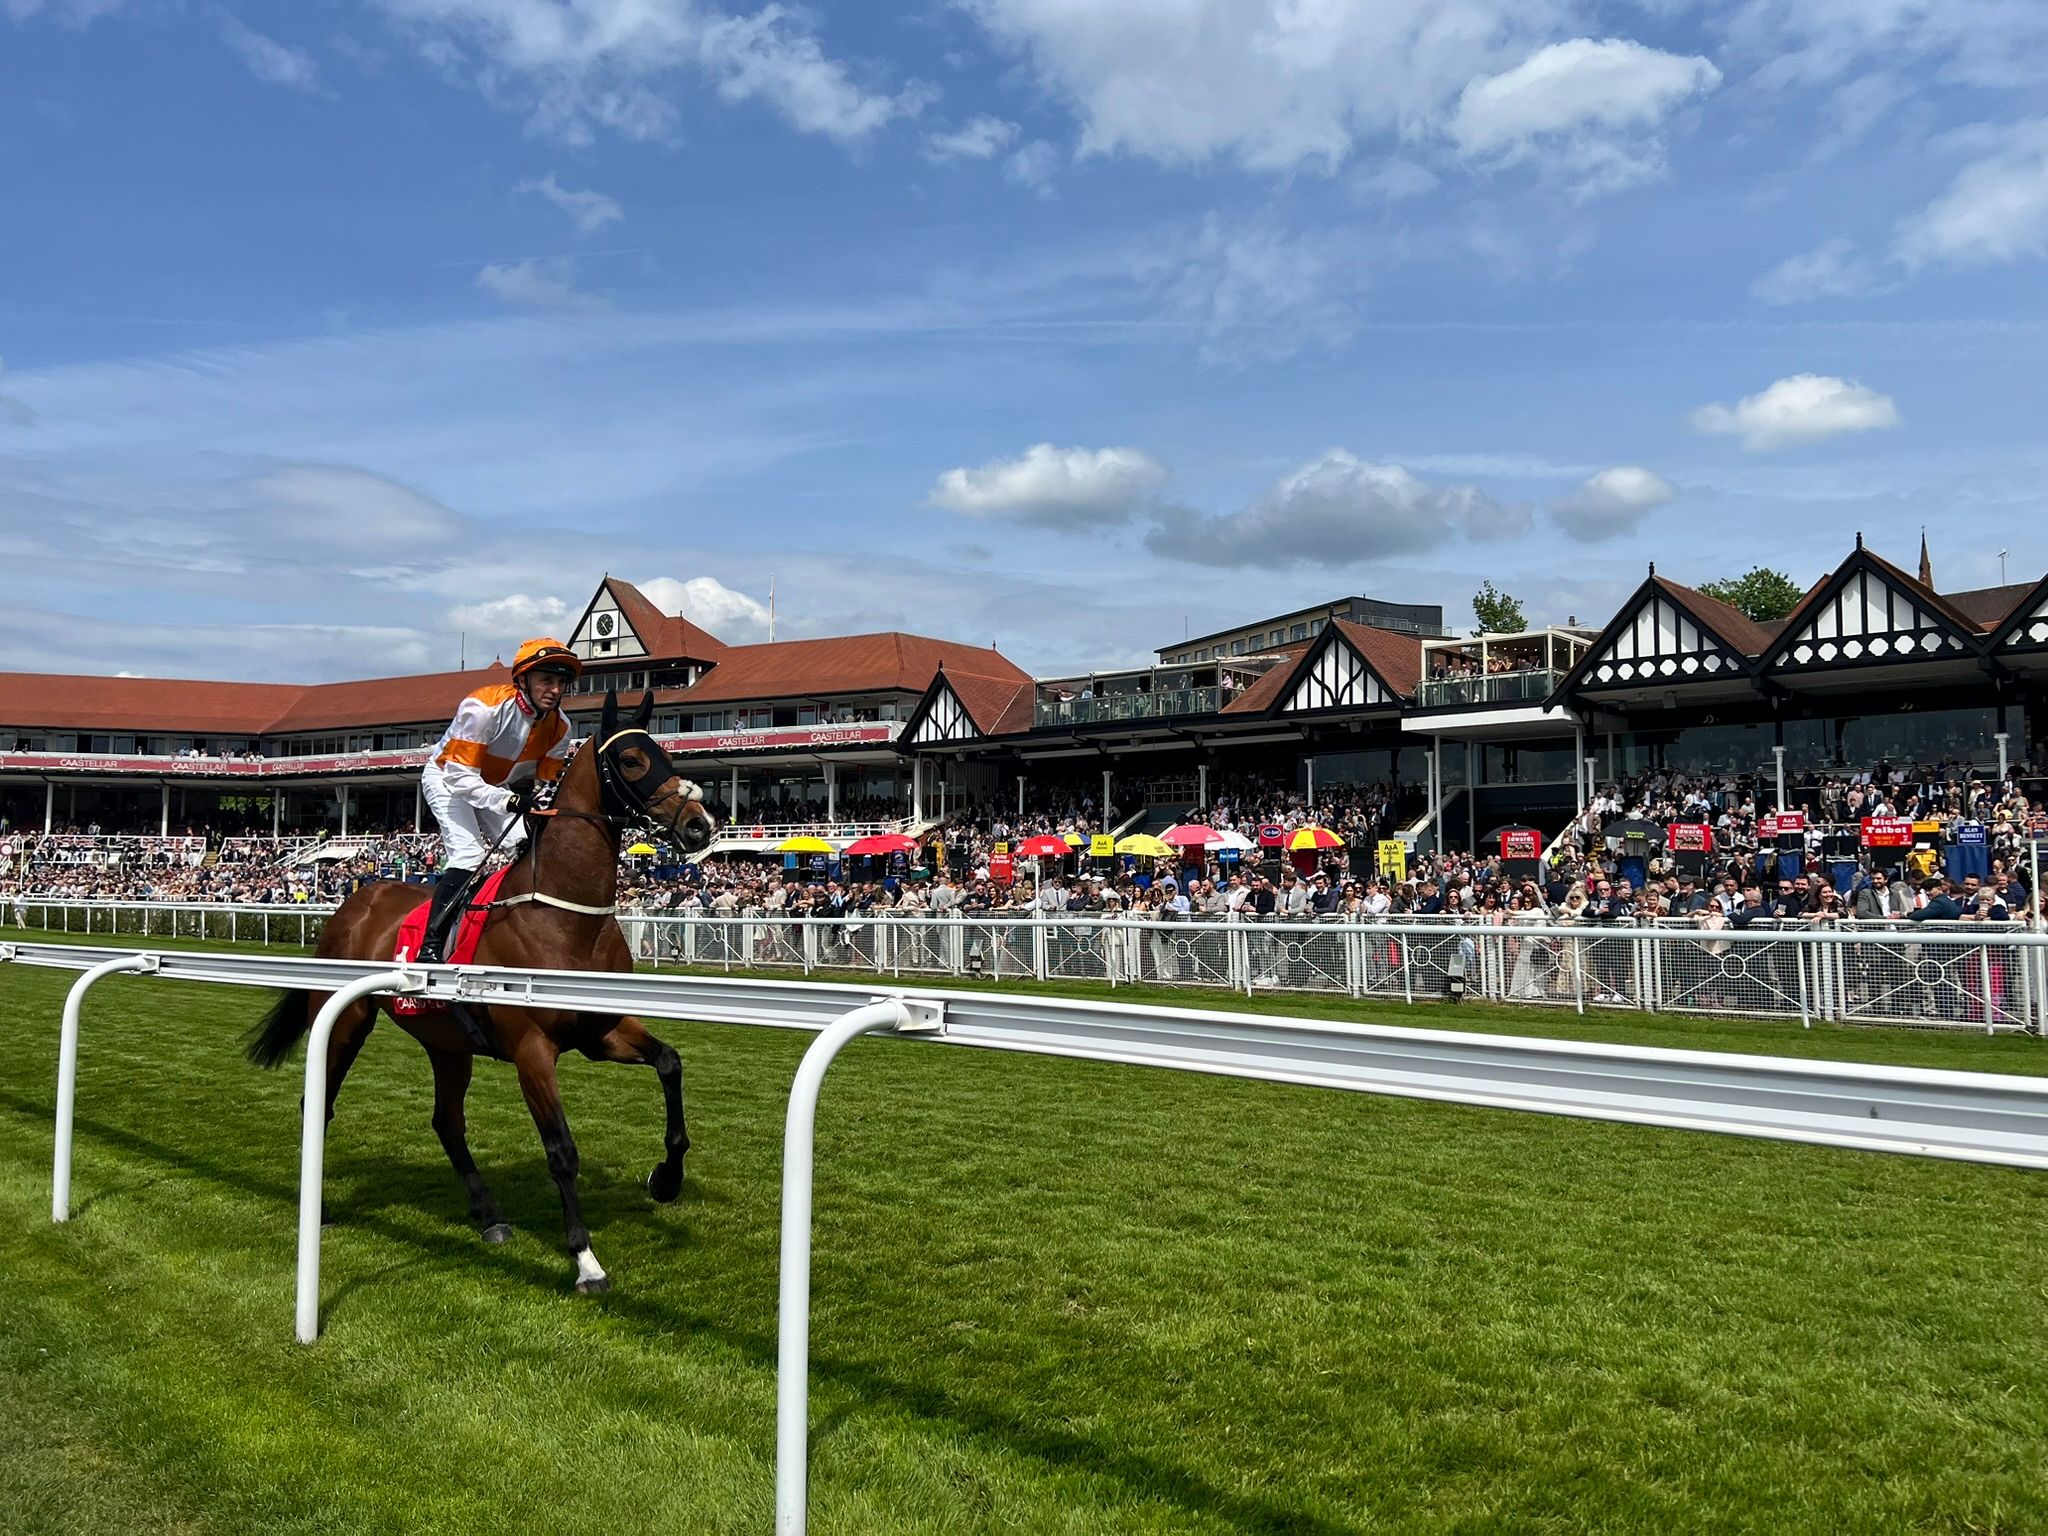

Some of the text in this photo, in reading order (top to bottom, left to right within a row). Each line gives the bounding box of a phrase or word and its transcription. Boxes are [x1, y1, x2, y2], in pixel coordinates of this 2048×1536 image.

[811, 731, 861, 741] CAASTELLAR
[717, 737, 765, 746] CAASTELLAR
[60, 759, 118, 768] CAASTELLAR
[402, 755, 429, 764] CAASTEL
[171, 762, 227, 771] CAASTELLAR
[1871, 818, 1901, 826] Dick
[1865, 826, 1907, 834] Talbot
